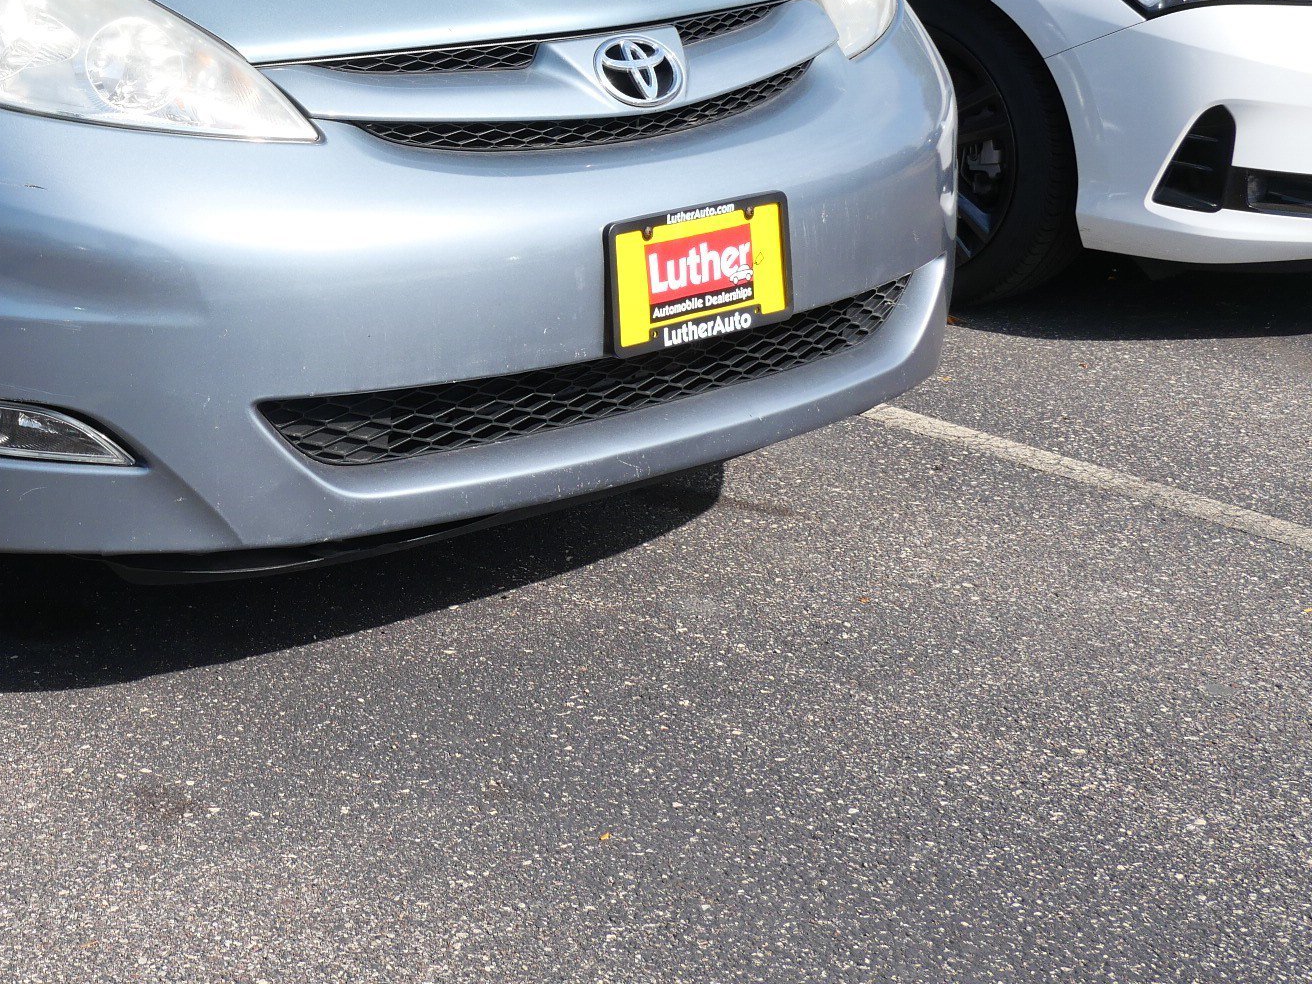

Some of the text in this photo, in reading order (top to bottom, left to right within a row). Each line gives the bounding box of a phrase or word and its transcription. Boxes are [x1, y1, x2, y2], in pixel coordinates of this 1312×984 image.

[666, 203, 735, 225] LutherAuto.com
[648, 241, 751, 294] Luther
[652, 285, 753, 319] Automobile Dealerships
[663, 312, 752, 347] LutherAuto
